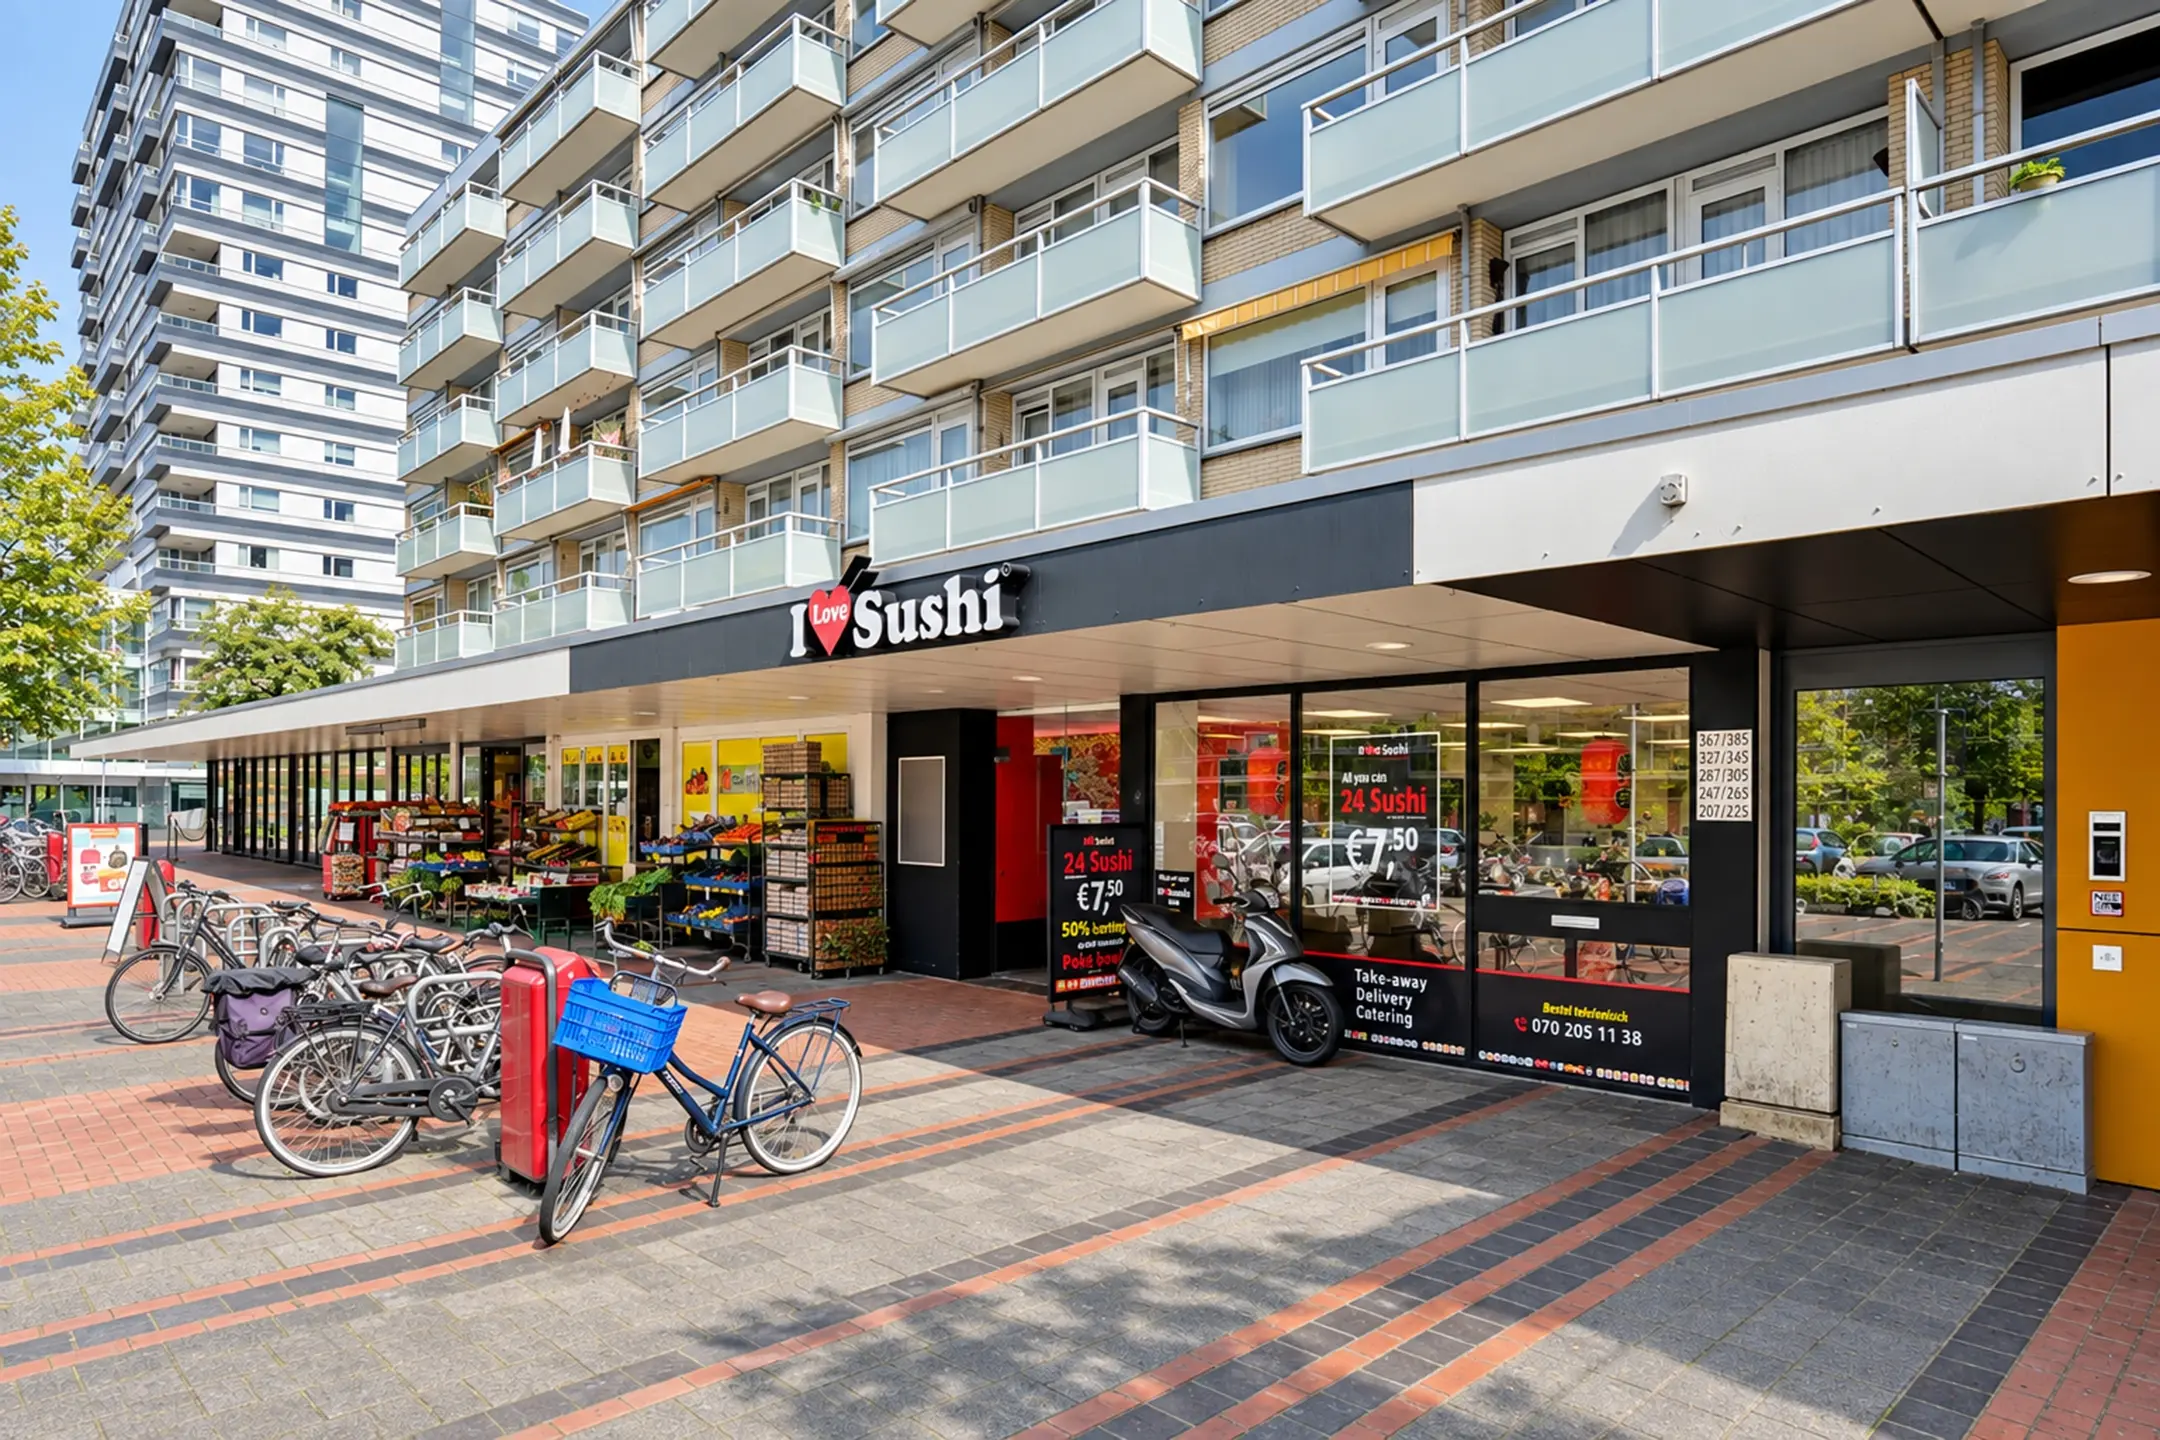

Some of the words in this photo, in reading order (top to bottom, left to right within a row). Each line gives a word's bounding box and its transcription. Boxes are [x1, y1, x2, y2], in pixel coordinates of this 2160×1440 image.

[790, 604, 808, 658] I
[813, 602, 848, 625] Love
[853, 568, 1003, 649] Sushi
[1699, 732, 1749, 747] 367/385
[1699, 750, 1749, 764] 327/345
[1340, 788, 1365, 813] 24
[1370, 785, 1427, 814] Sushi
[1699, 785, 1749, 800] 247/265
[1699, 804, 1749, 818] 207/225
[1064, 851, 1086, 874] 24
[1090, 850, 1133, 873] Sushi
[1062, 921, 1090, 938] 50%
[1354, 968, 1427, 993] Take-away
[1356, 987, 1412, 1011] Delivery
[1356, 1005, 1413, 1029] Catering
[1532, 1018, 1560, 1036] 070
[1564, 1022, 1593, 1040] 205
[1598, 1026, 1615, 1043] 11
[1621, 1029, 1643, 1046] 38
